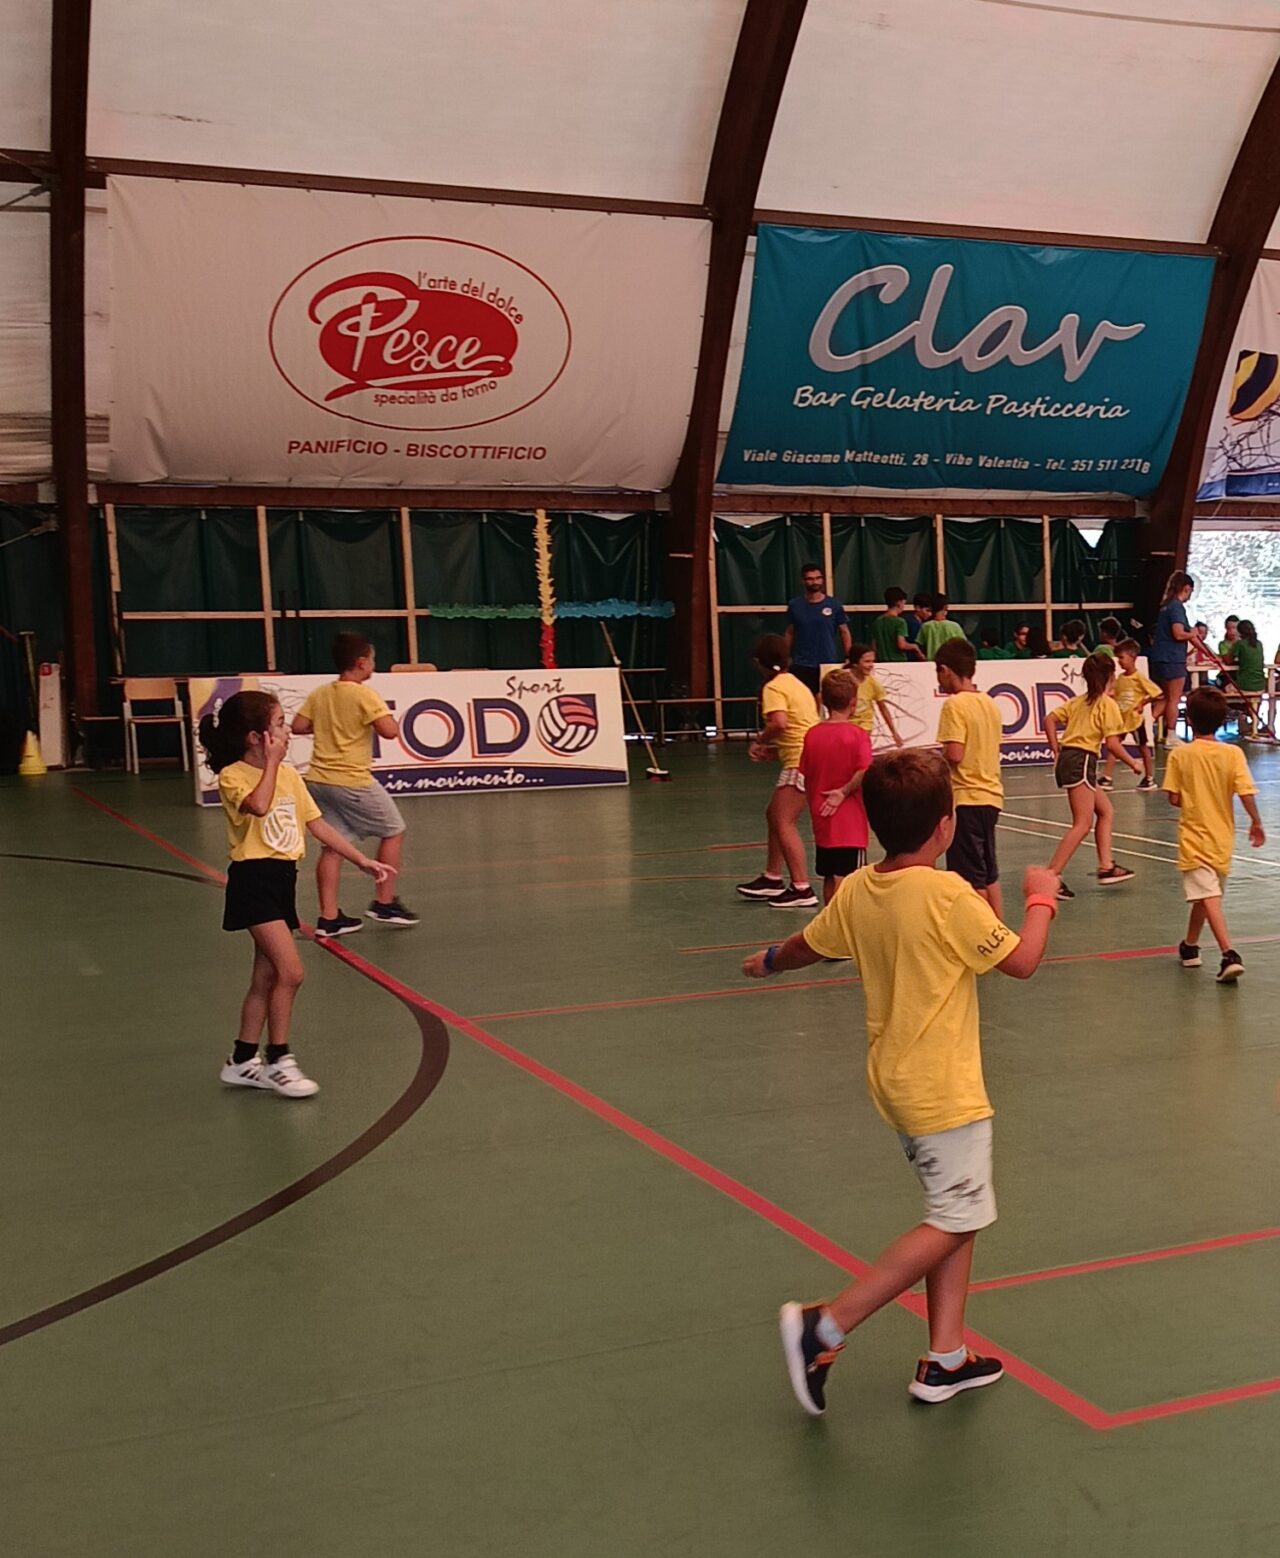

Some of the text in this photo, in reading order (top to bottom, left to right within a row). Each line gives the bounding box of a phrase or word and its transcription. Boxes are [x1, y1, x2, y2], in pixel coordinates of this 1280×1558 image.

[461, 278, 486, 298] del
[486, 287, 524, 325] dolce
[336, 299, 505, 372] Pesce
[809, 264, 1145, 382] Clav
[440, 387, 458, 402] da
[793, 386, 1130, 418] Bar Gelateria Pasticceria
[287, 439, 388, 455] PANIFICIO
[406, 443, 547, 460] BISCOTTIFICIO
[743, 449, 777, 462] Viale
[782, 450, 840, 463] Giacomo
[945, 453, 973, 465] Vibo
[978, 455, 1030, 469] Valentia
[1070, 459, 1094, 471] 351
[1096, 459, 1118, 471] 511
[505, 676, 565, 700] Sport
[384, 774, 411, 790] in
[977, 925, 1010, 957] ALES
